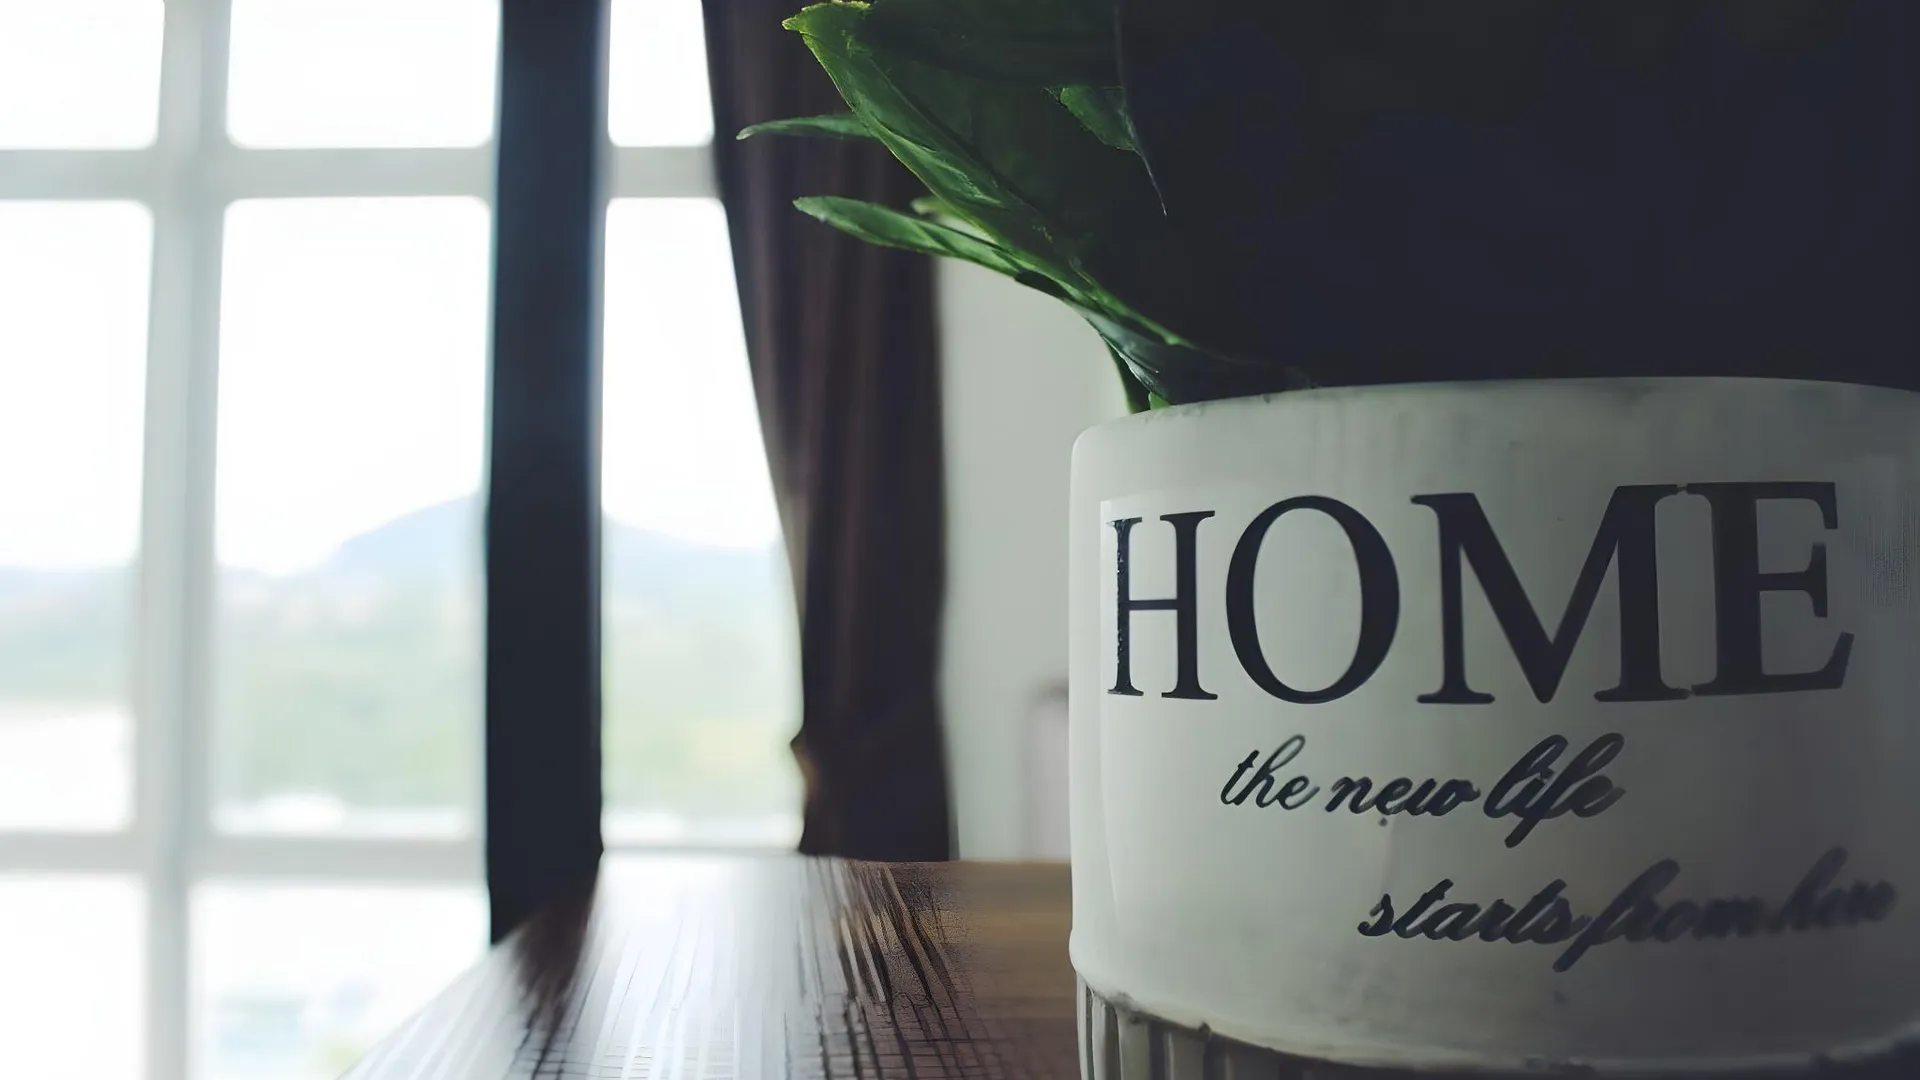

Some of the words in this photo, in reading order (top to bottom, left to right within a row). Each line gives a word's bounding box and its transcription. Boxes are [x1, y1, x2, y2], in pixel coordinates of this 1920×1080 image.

[1105, 481, 1855, 704] HOME
[1220, 734, 1320, 811] the
[1325, 775, 1481, 819] new
[1483, 732, 1627, 848] life
[1357, 878, 1582, 944] starts
[1553, 858, 1764, 973] from
